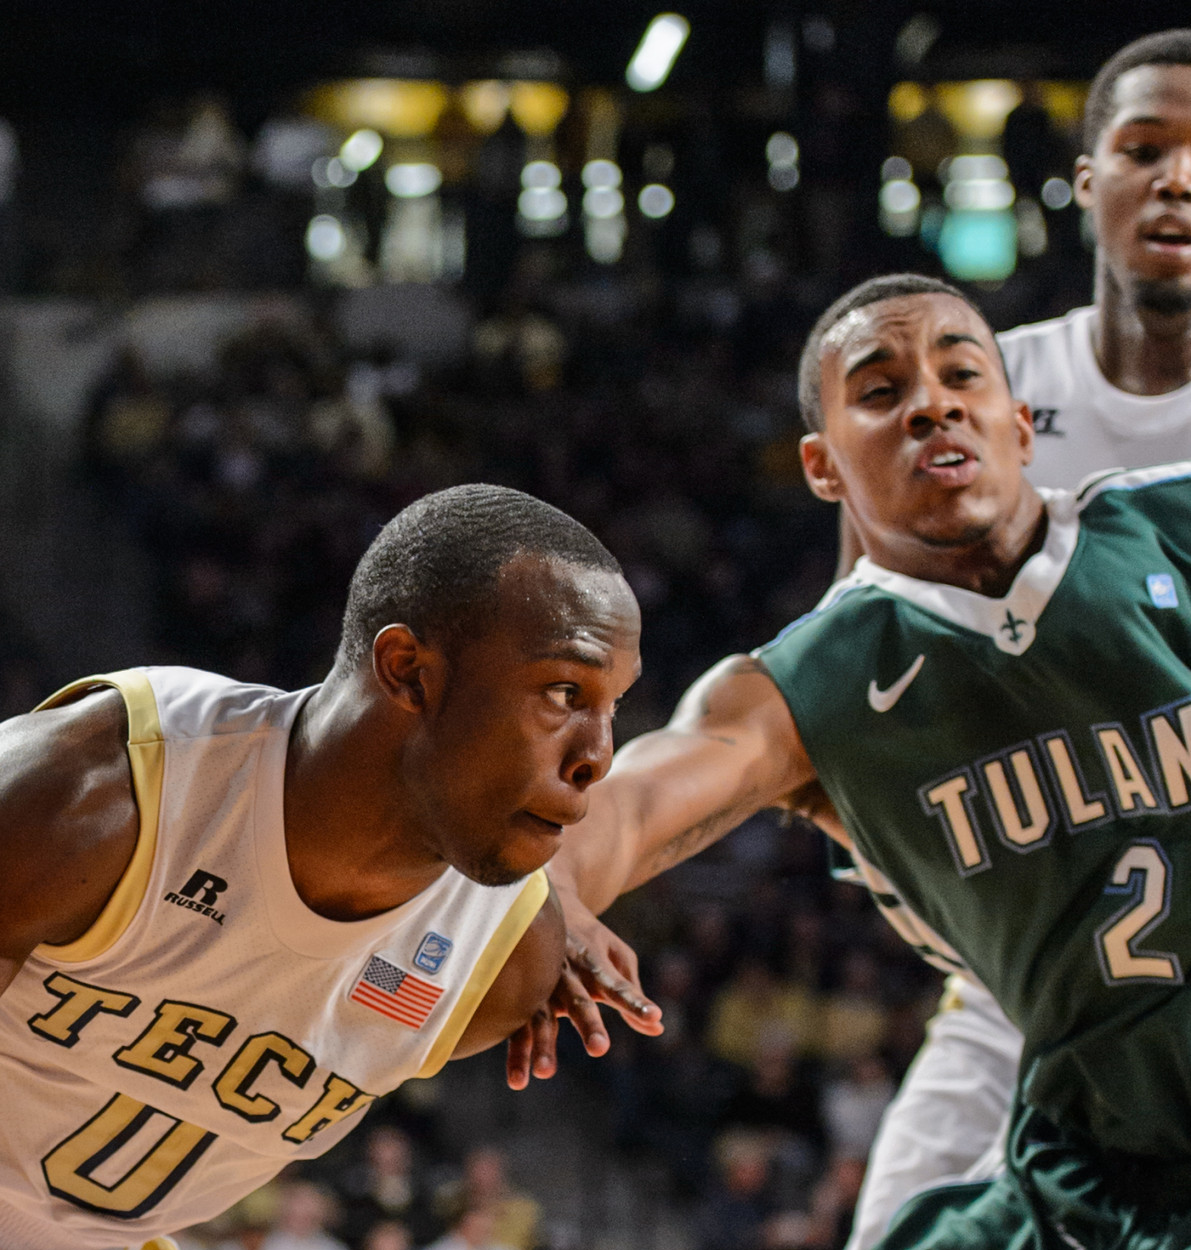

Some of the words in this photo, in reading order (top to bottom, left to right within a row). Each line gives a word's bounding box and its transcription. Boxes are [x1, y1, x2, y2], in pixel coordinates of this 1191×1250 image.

[178, 868, 228, 907] R
[163, 891, 226, 926] RUSSELL
[1094, 837, 1185, 987] 2
